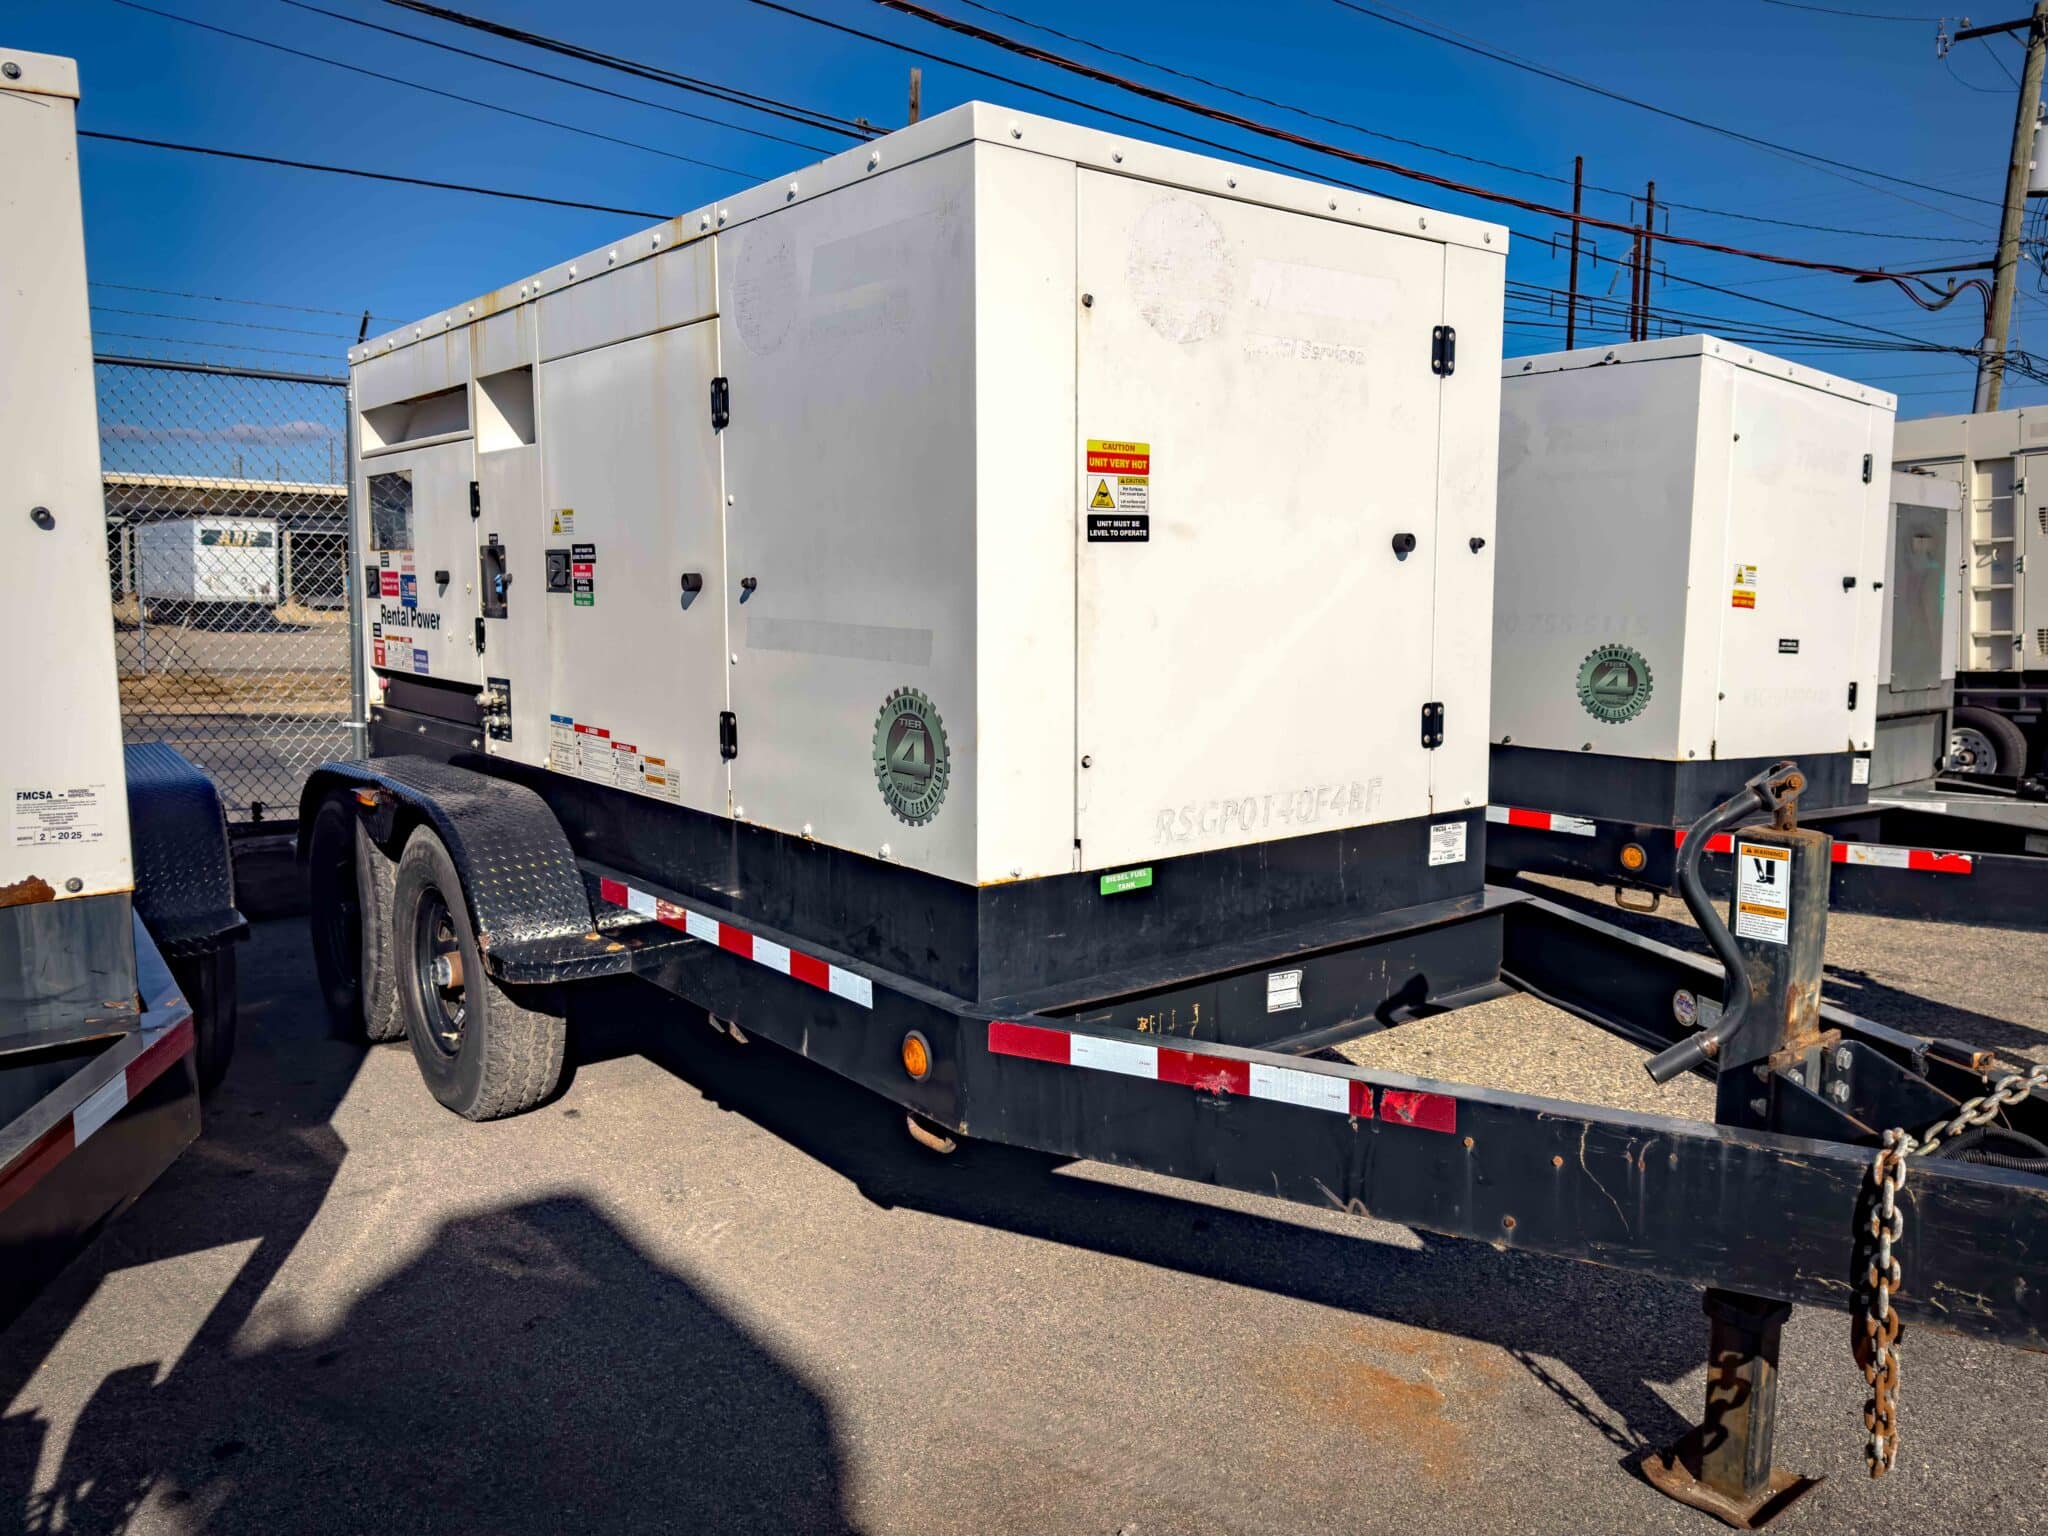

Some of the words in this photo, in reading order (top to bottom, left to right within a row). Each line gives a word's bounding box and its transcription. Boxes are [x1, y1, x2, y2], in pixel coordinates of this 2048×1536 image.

[1102, 442, 1136, 452] CAUTION
[1089, 457, 1107, 467] UNIT
[1109, 458, 1130, 468] VERY
[1131, 460, 1148, 470] HOT
[1113, 520, 1130, 528] MUST
[1089, 529, 1109, 537] LEVEL
[1119, 529, 1147, 537] OPERATE
[380, 604, 409, 627] Rental
[411, 607, 440, 630] Power
[1594, 667, 1634, 700] 4
[892, 697, 928, 720] CUMMINS
[899, 718, 922, 730] TIER
[891, 728, 931, 785] 4
[878, 757, 888, 779] THE
[886, 783, 907, 812] RIGHT
[911, 758, 944, 815] TECHNOLOGY
[16, 791, 53, 801] FMCSA
[40, 833, 46, 841] 2
[1753, 848, 1784, 858] WARNING
